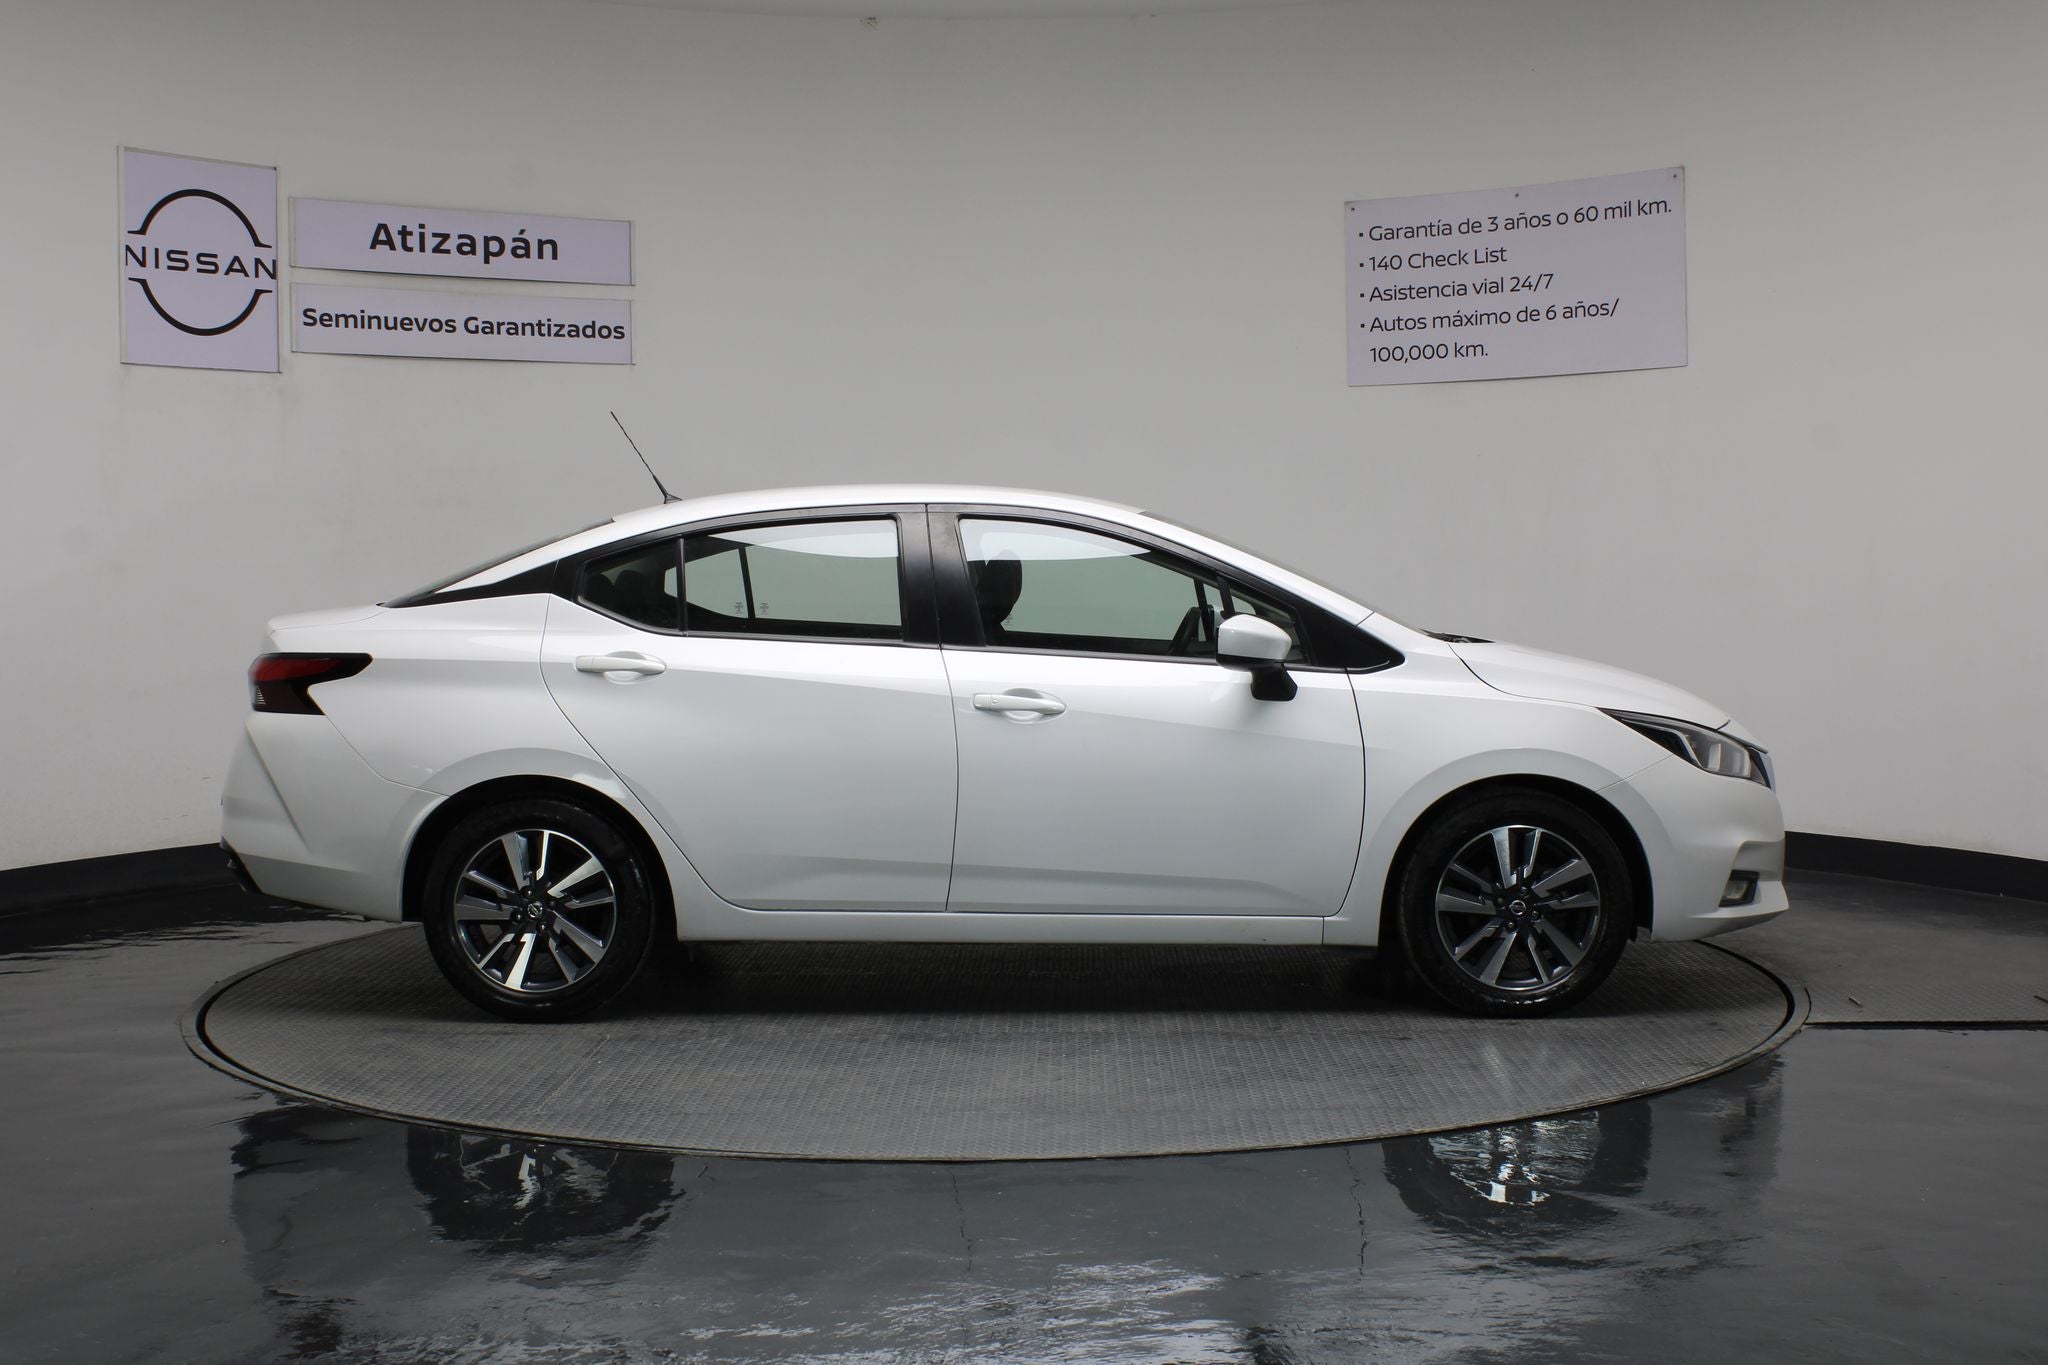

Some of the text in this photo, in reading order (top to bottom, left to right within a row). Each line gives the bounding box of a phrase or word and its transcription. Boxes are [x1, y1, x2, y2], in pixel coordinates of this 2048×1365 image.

[1369, 198, 1673, 242] Garantía de 3 años o 60 mil km.
[369, 222, 559, 264] Atizapán
[1369, 246, 1508, 272] 140 Check List
[125, 244, 278, 280] NISSAN
[1369, 273, 1554, 303] Asistencia vial 24/7
[303, 307, 626, 340] Seminuevos Garantizados
[1370, 297, 1620, 333] Autos máximo de 6 años/
[1370, 341, 1489, 364] 100,000 km.
